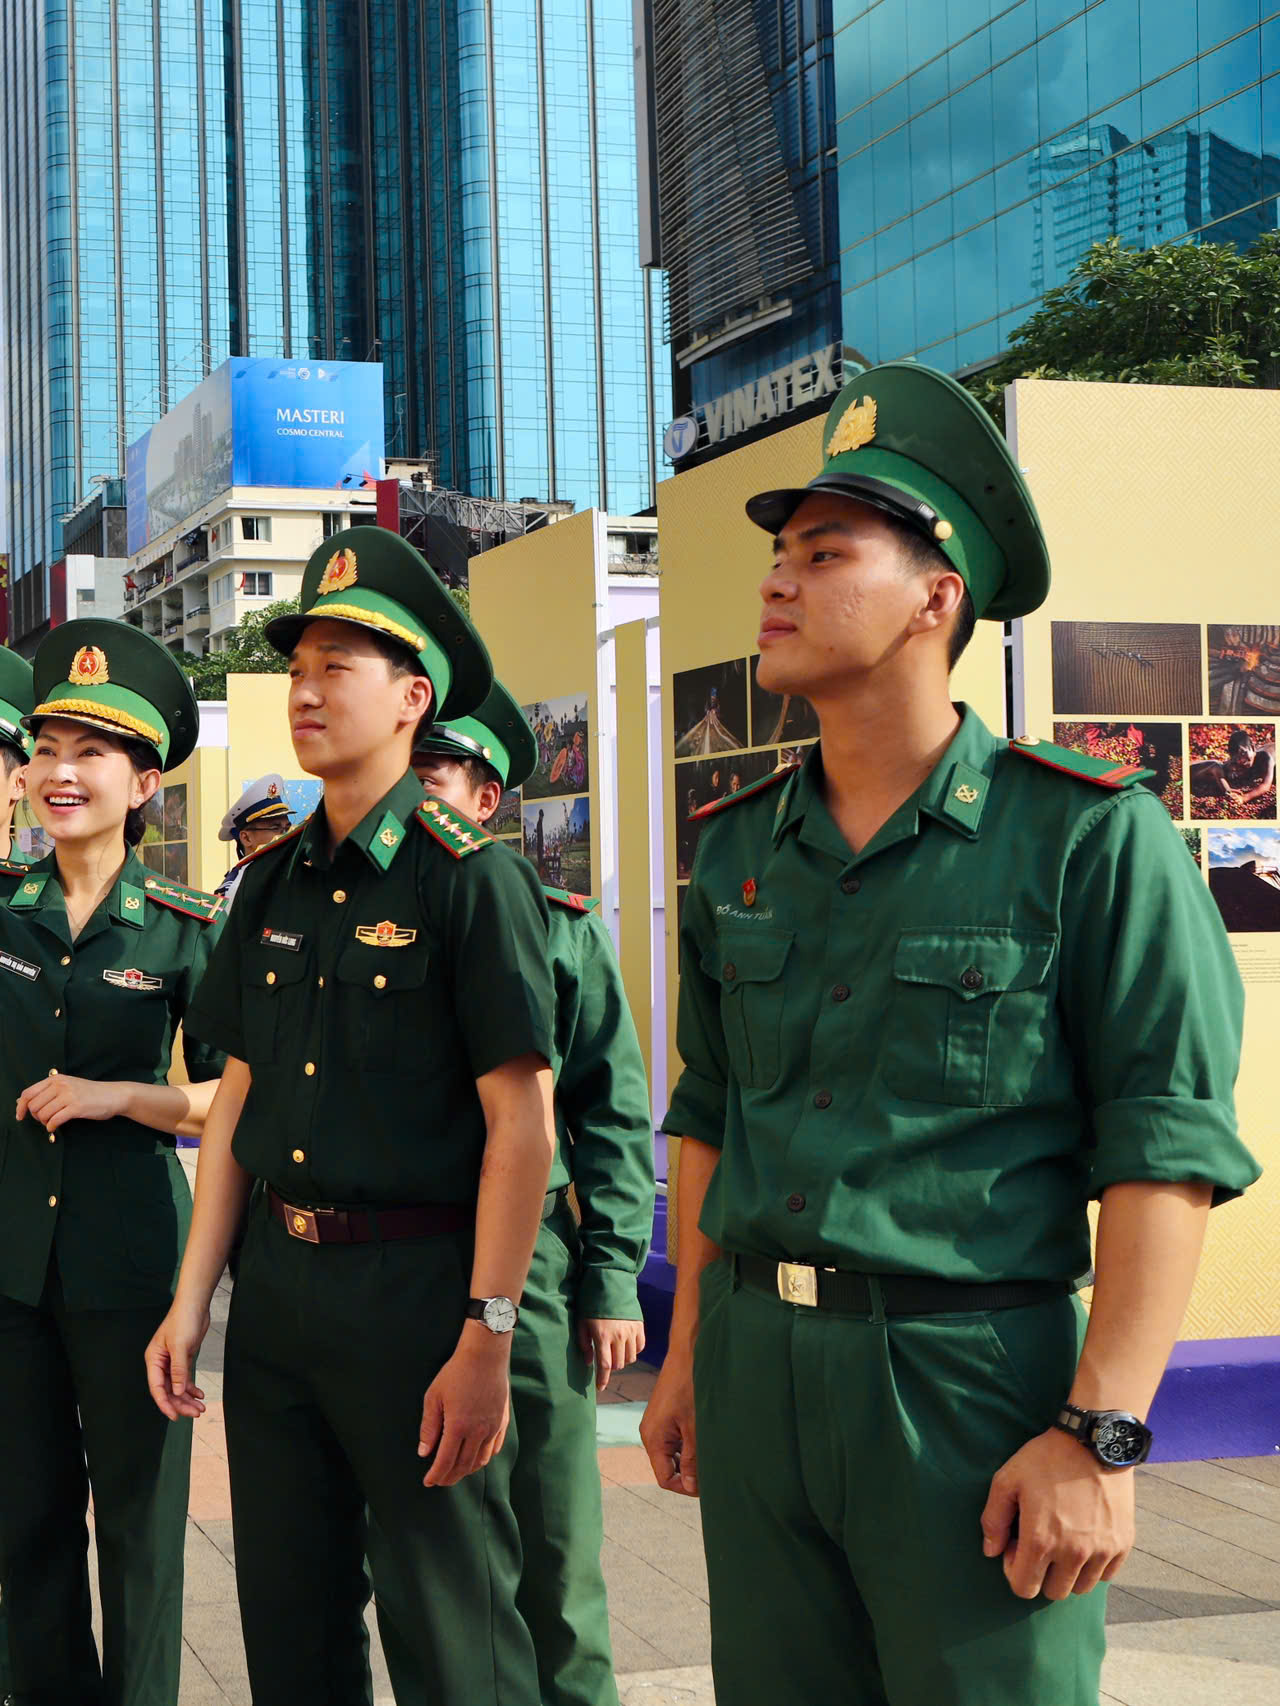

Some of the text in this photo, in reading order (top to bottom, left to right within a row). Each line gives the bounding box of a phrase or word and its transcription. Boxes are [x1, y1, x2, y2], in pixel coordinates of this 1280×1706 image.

[704, 343, 838, 443] VINATEX
[276, 408, 345, 424] MASTERI
[276, 427, 345, 439] COSMO CENTRAL
